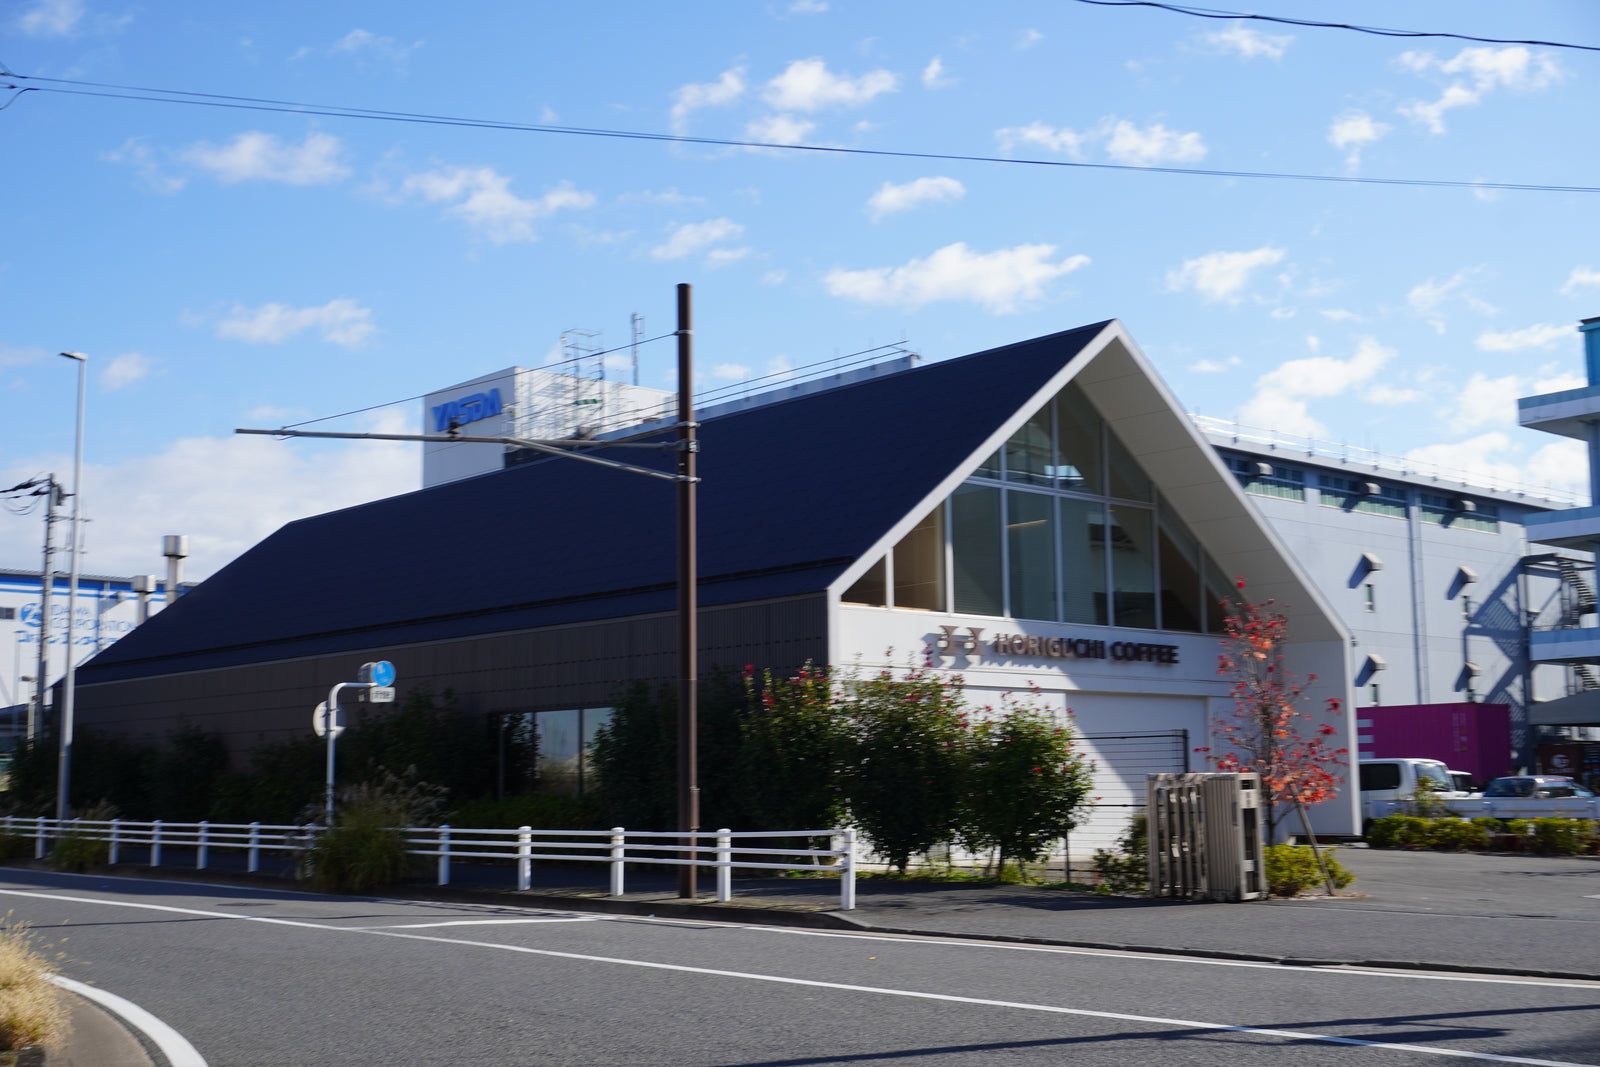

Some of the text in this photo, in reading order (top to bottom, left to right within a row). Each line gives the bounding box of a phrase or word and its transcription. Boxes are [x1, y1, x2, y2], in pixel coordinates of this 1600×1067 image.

[432, 388, 501, 432] YASDA
[995, 633, 1180, 664] HORIGUCHI COFFEE
